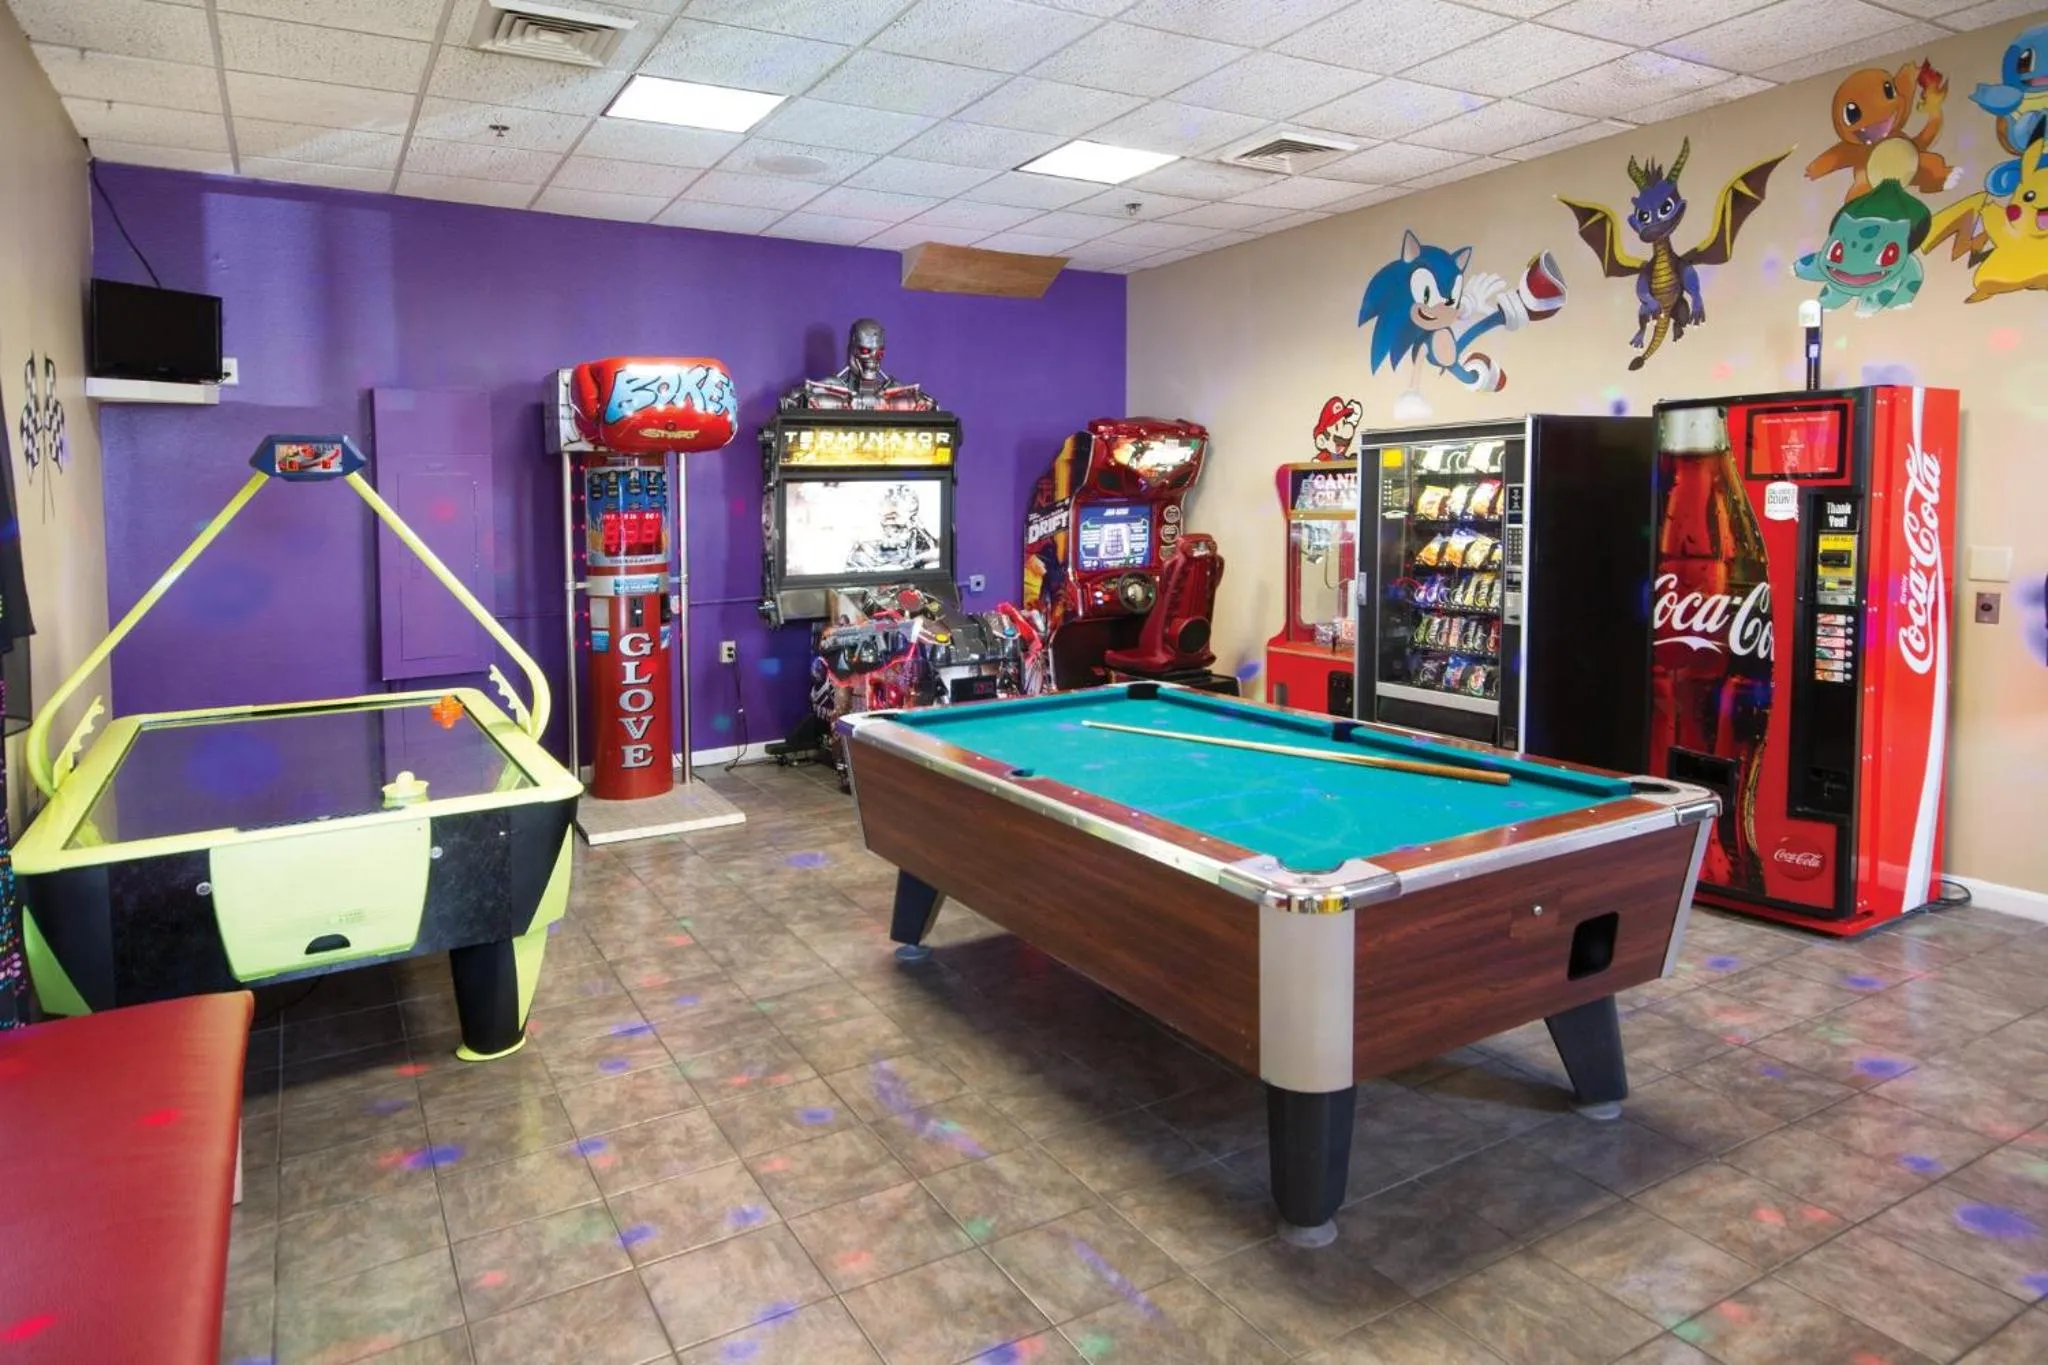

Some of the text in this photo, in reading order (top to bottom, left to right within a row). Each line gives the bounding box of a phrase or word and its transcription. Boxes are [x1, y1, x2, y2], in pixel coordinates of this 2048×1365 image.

[784, 431, 951, 444] TERMINATOR
[1826, 501, 1852, 515] Thank
[1028, 510, 1069, 545] DRIFT
[1899, 443, 1942, 675] Coca-Cola
[1653, 573, 1774, 661] oca-Co
[619, 632, 654, 769] GLOVE
[1774, 848, 1823, 868] Coca-Cola
